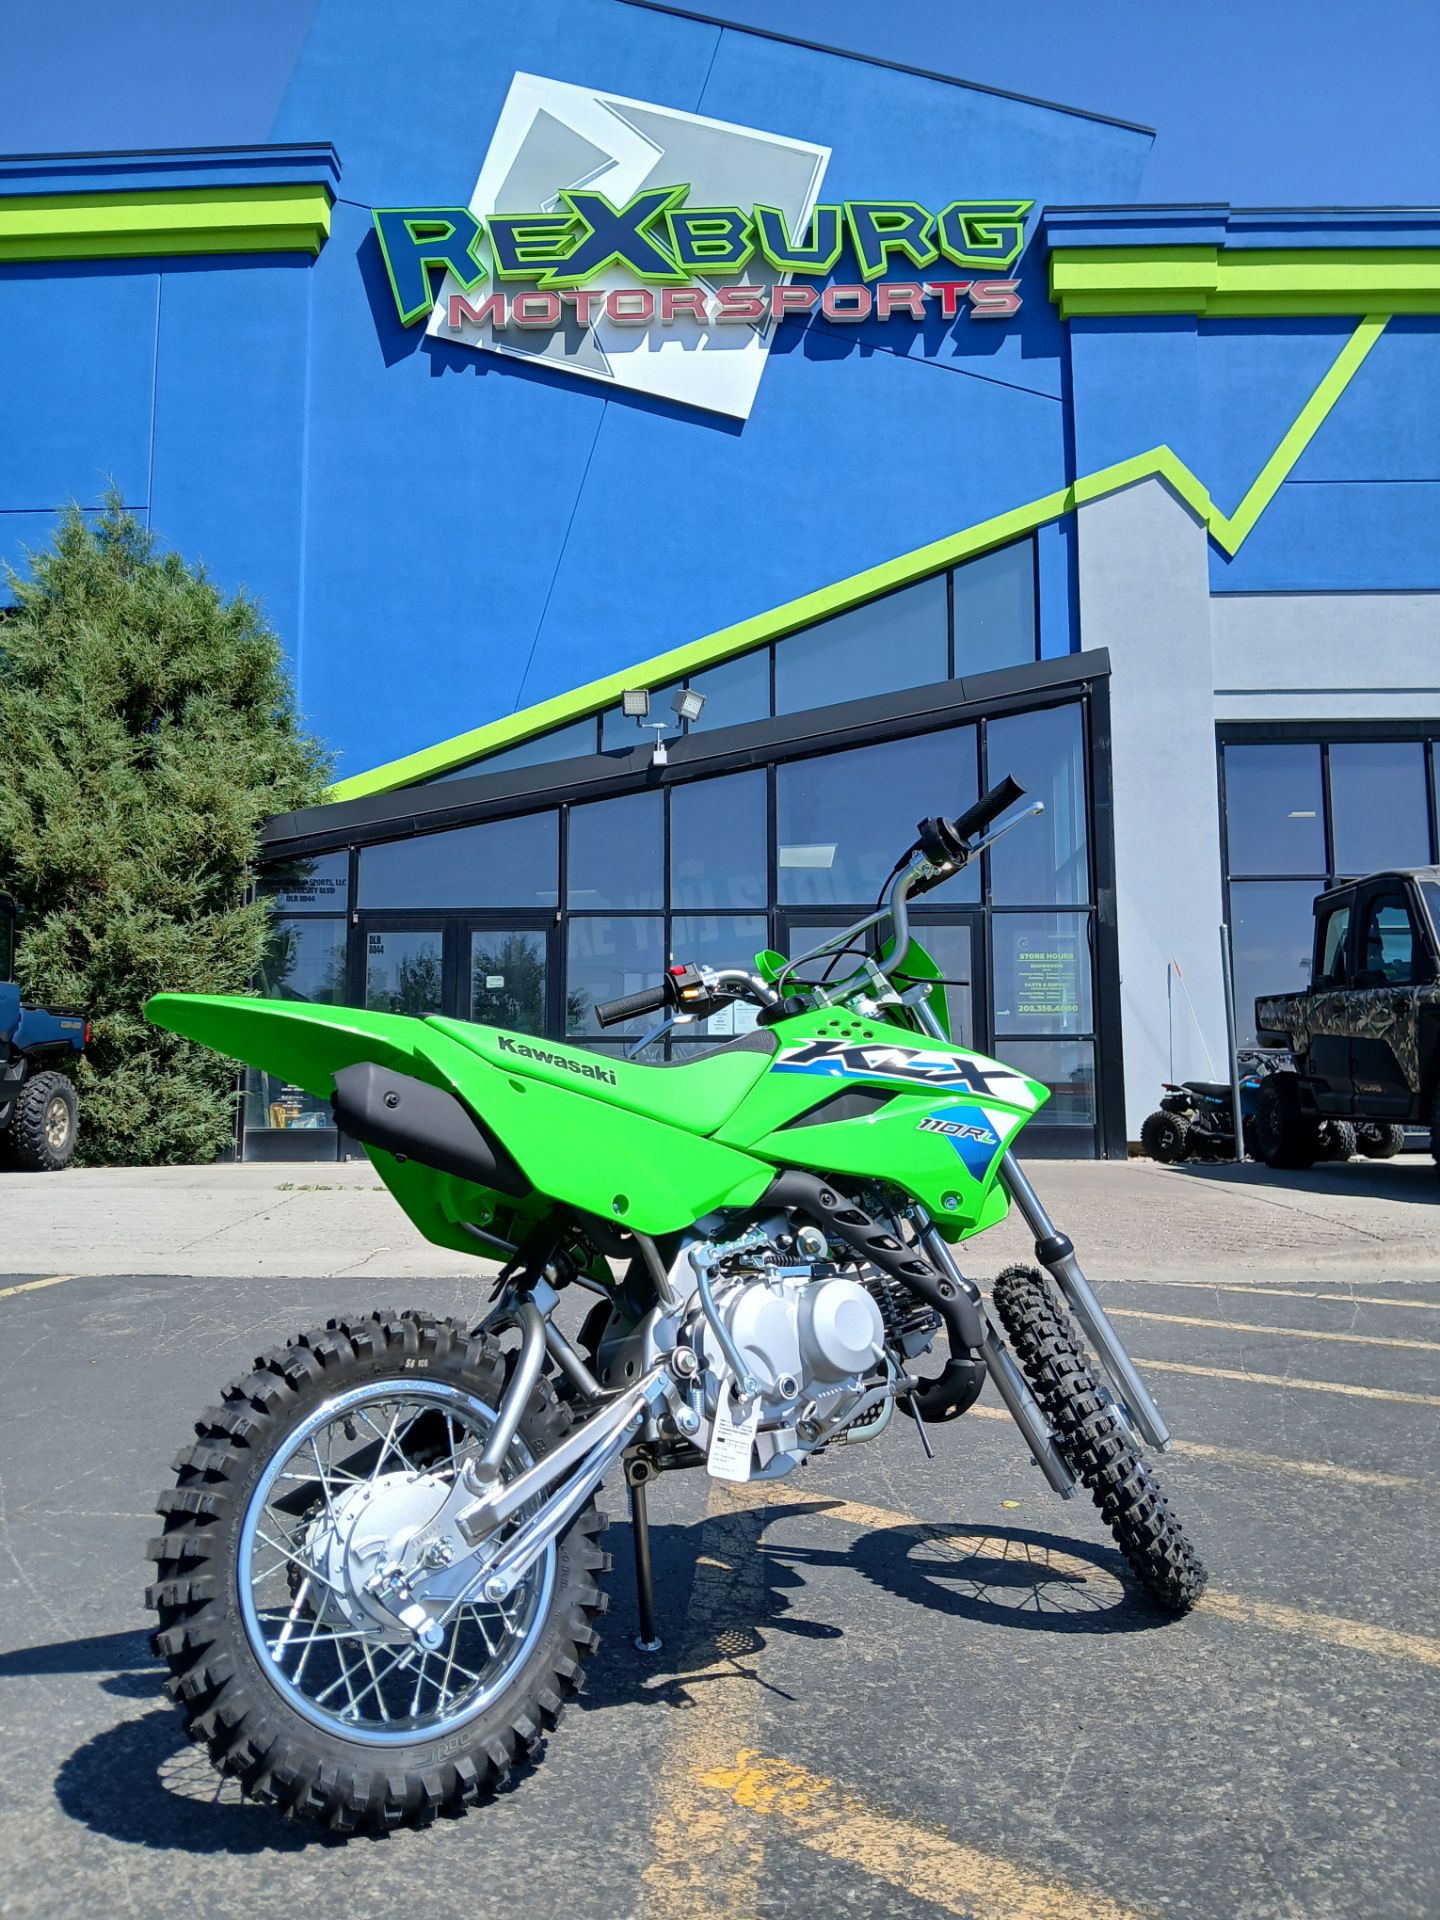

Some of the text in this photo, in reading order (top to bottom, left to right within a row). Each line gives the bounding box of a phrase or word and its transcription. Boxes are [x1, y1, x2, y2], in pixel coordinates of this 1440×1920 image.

[371, 183, 1036, 328] REXBURG
[447, 279, 1024, 332] MOTORSPORTS
[335, 878, 347, 886] LLC
[369, 935, 381, 944] DLR
[1019, 952, 1074, 960] STORE HOURS
[497, 1035, 617, 1086] Kawasaki
[779, 1039, 1024, 1098] KLX
[914, 1117, 998, 1145] 110RL
